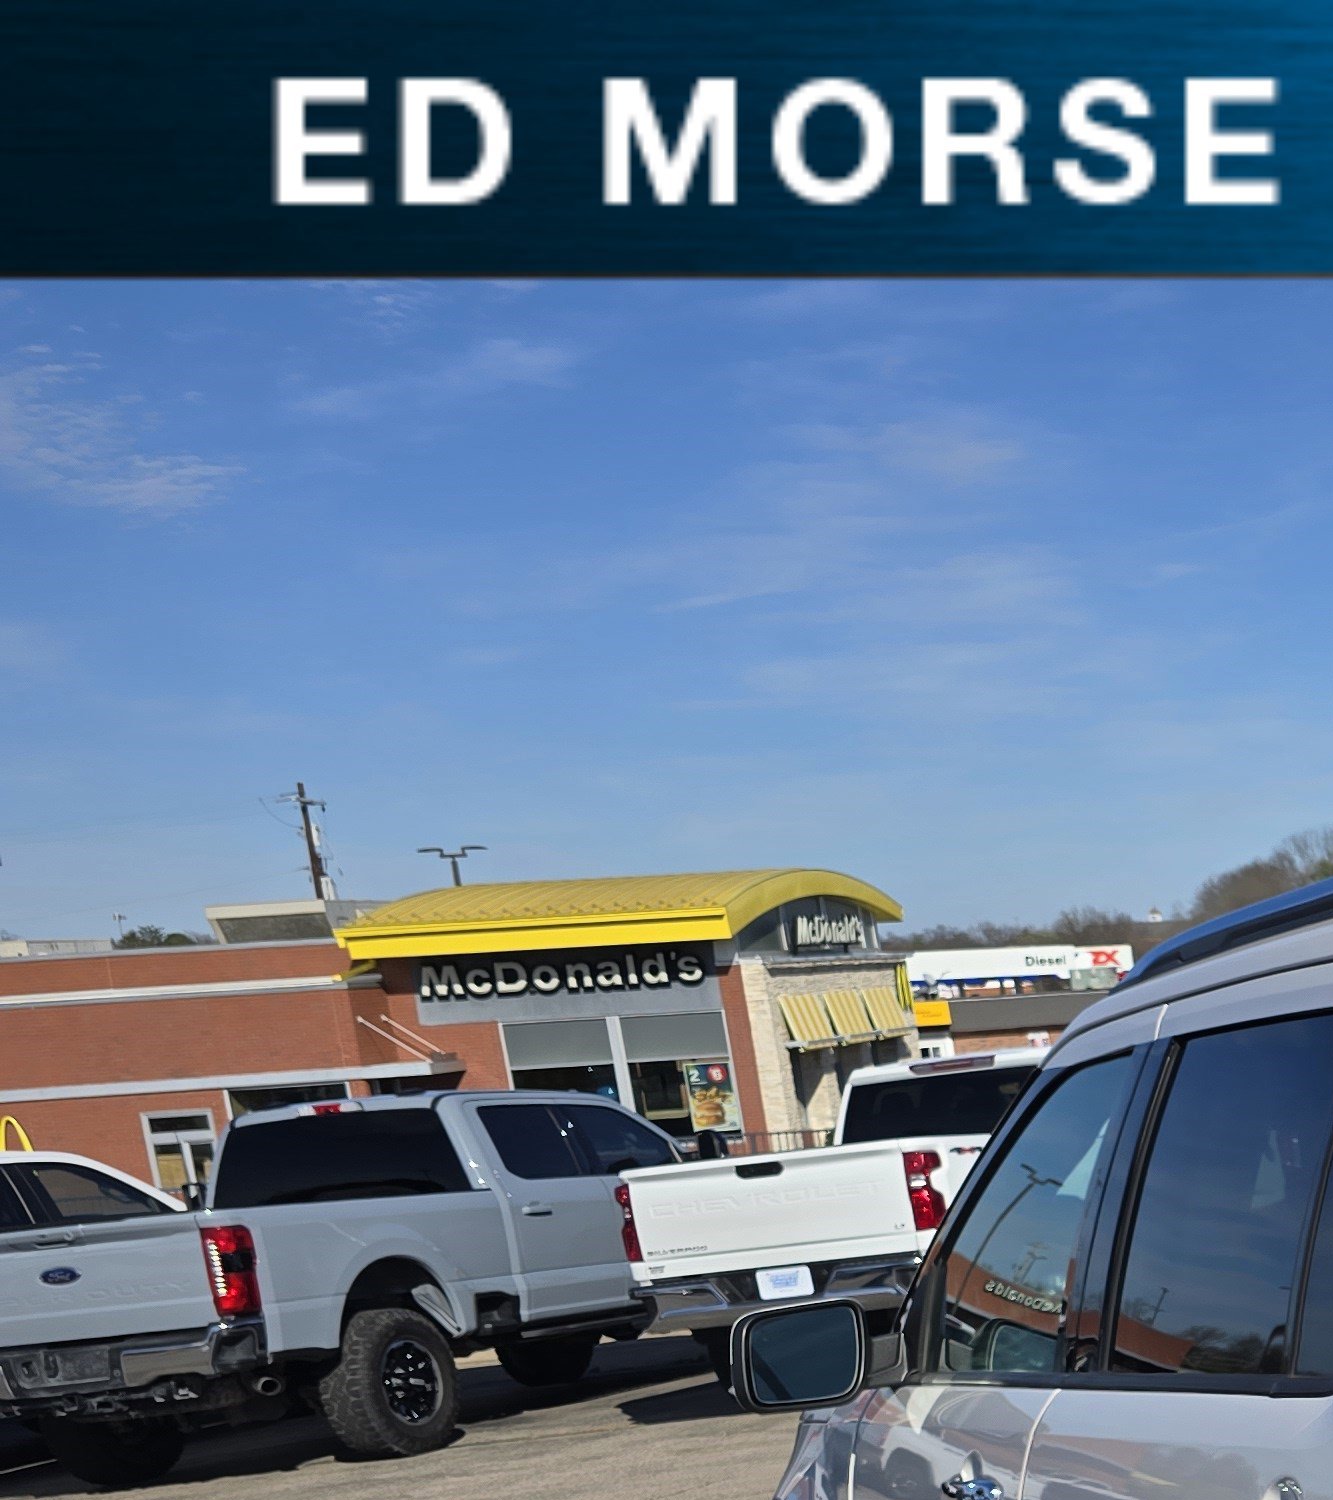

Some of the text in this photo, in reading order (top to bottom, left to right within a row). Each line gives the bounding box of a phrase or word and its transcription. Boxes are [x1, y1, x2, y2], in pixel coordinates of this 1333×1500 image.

[797, 914, 867, 948] McDonald's
[420, 953, 704, 999] McDonald's
[1025, 954, 1067, 967] Diesel
